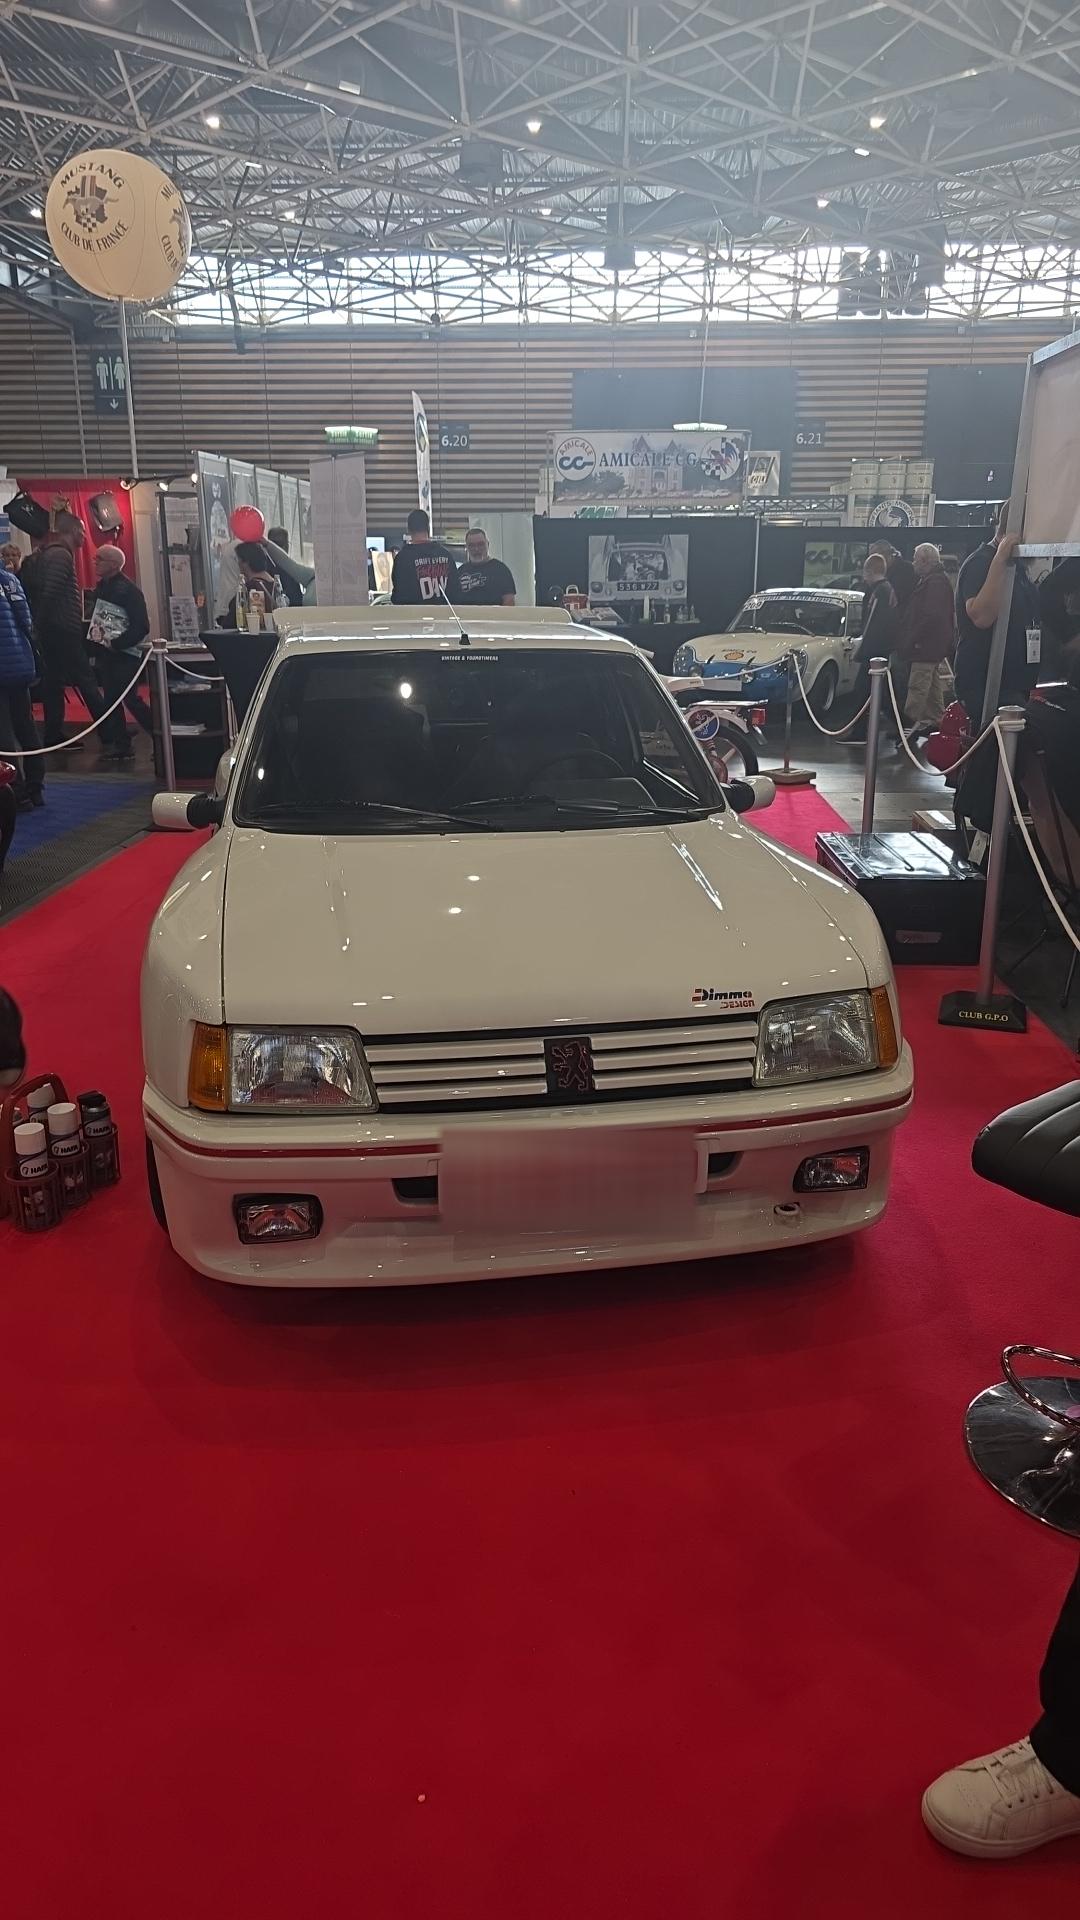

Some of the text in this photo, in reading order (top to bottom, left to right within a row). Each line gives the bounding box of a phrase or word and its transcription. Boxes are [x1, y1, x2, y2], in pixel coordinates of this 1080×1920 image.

[60, 162, 125, 189] MUSTANG
[60, 220, 129, 252] CLUB DE FRANCE
[441, 435, 468, 448] 6.20
[796, 432, 822, 445] 6.21
[559, 439, 594, 456] AMICALE
[599, 452, 672, 467] AMICALE
[432, 556, 449, 564] EVERY
[691, 988, 753, 1002] Dimma
[958, 1010, 1009, 1022] CLUB G.P.O
